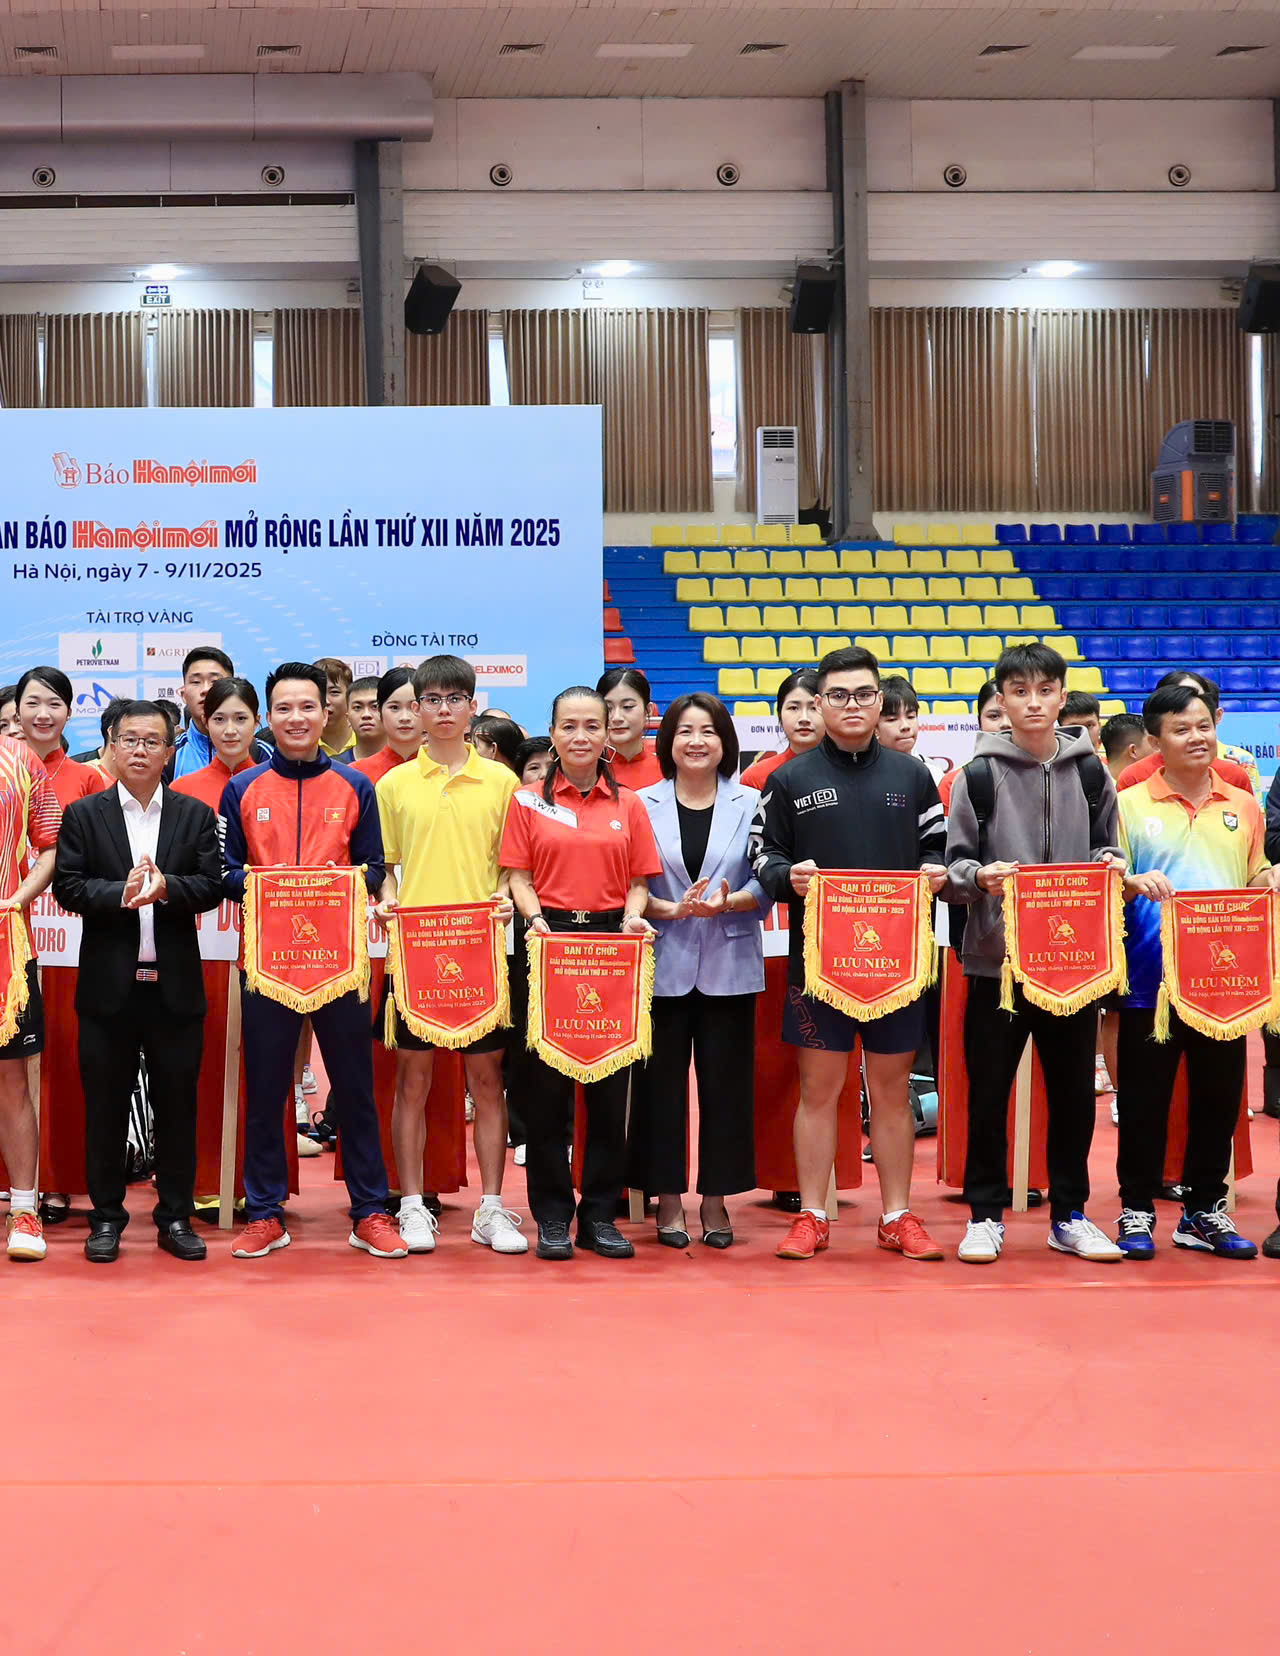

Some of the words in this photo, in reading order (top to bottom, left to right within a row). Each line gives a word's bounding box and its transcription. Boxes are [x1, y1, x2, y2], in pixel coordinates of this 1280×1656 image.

[146, 295, 167, 304] EXIT
[86, 462, 130, 485] Báo
[133, 459, 257, 487] Hànộimới
[25, 514, 67, 549] BÁO
[72, 520, 218, 552] Hànộimới
[225, 510, 259, 548] MỞ
[265, 513, 321, 554] RỘNG
[328, 509, 368, 547] LẦN
[375, 512, 417, 547] THỨ
[421, 518, 448, 547] XII
[455, 513, 503, 547] NĂM
[510, 517, 560, 547] 2025
[13, 562, 39, 579] Hà
[45, 562, 81, 582] Nội,
[87, 563, 132, 582] ngày
[137, 564, 148, 579] 7
[165, 562, 262, 579] 9/11/2025
[87, 609, 110, 624] TÀI
[114, 611, 144, 626] TRỢ
[148, 609, 193, 624] VÀNG
[372, 631, 417, 646] ĐỒNG
[421, 631, 444, 646] TÀI
[448, 634, 478, 649] TRỢ
[76, 658, 119, 666] PETROVIETNAM
[948, 723, 958, 731] MỞ
[960, 724, 979, 733] RỘNG
[794, 795, 812, 809] VIET
[816, 790, 833, 802] ED
[842, 884, 858, 893] BAN
[861, 881, 872, 893] TỔ
[874, 882, 895, 893] CHỨC
[1036, 878, 1052, 888] BAN
[1055, 875, 1065, 887] TỔ
[1067, 875, 1088, 886] CHỨC
[419, 918, 436, 927] BAN
[438, 915, 449, 926] TỔ
[450, 915, 472, 926] CHỨC
[272, 950, 300, 961] LƯU
[303, 948, 338, 961] NIỆM
[564, 946, 581, 955] BAN
[584, 944, 594, 955] TỔ
[596, 945, 617, 955] CHỨC
[1029, 951, 1057, 963] LƯU
[1060, 948, 1095, 963] NIỆM
[834, 957, 862, 968] LƯU
[865, 956, 899, 969] NIỆM
[1191, 977, 1220, 989] LƯU
[1223, 974, 1258, 988] NIỆM
[418, 988, 447, 1000] LƯU
[449, 985, 484, 999] NIỆM
[556, 1019, 584, 1030] LƯU
[587, 1018, 621, 1031] NIỆM
